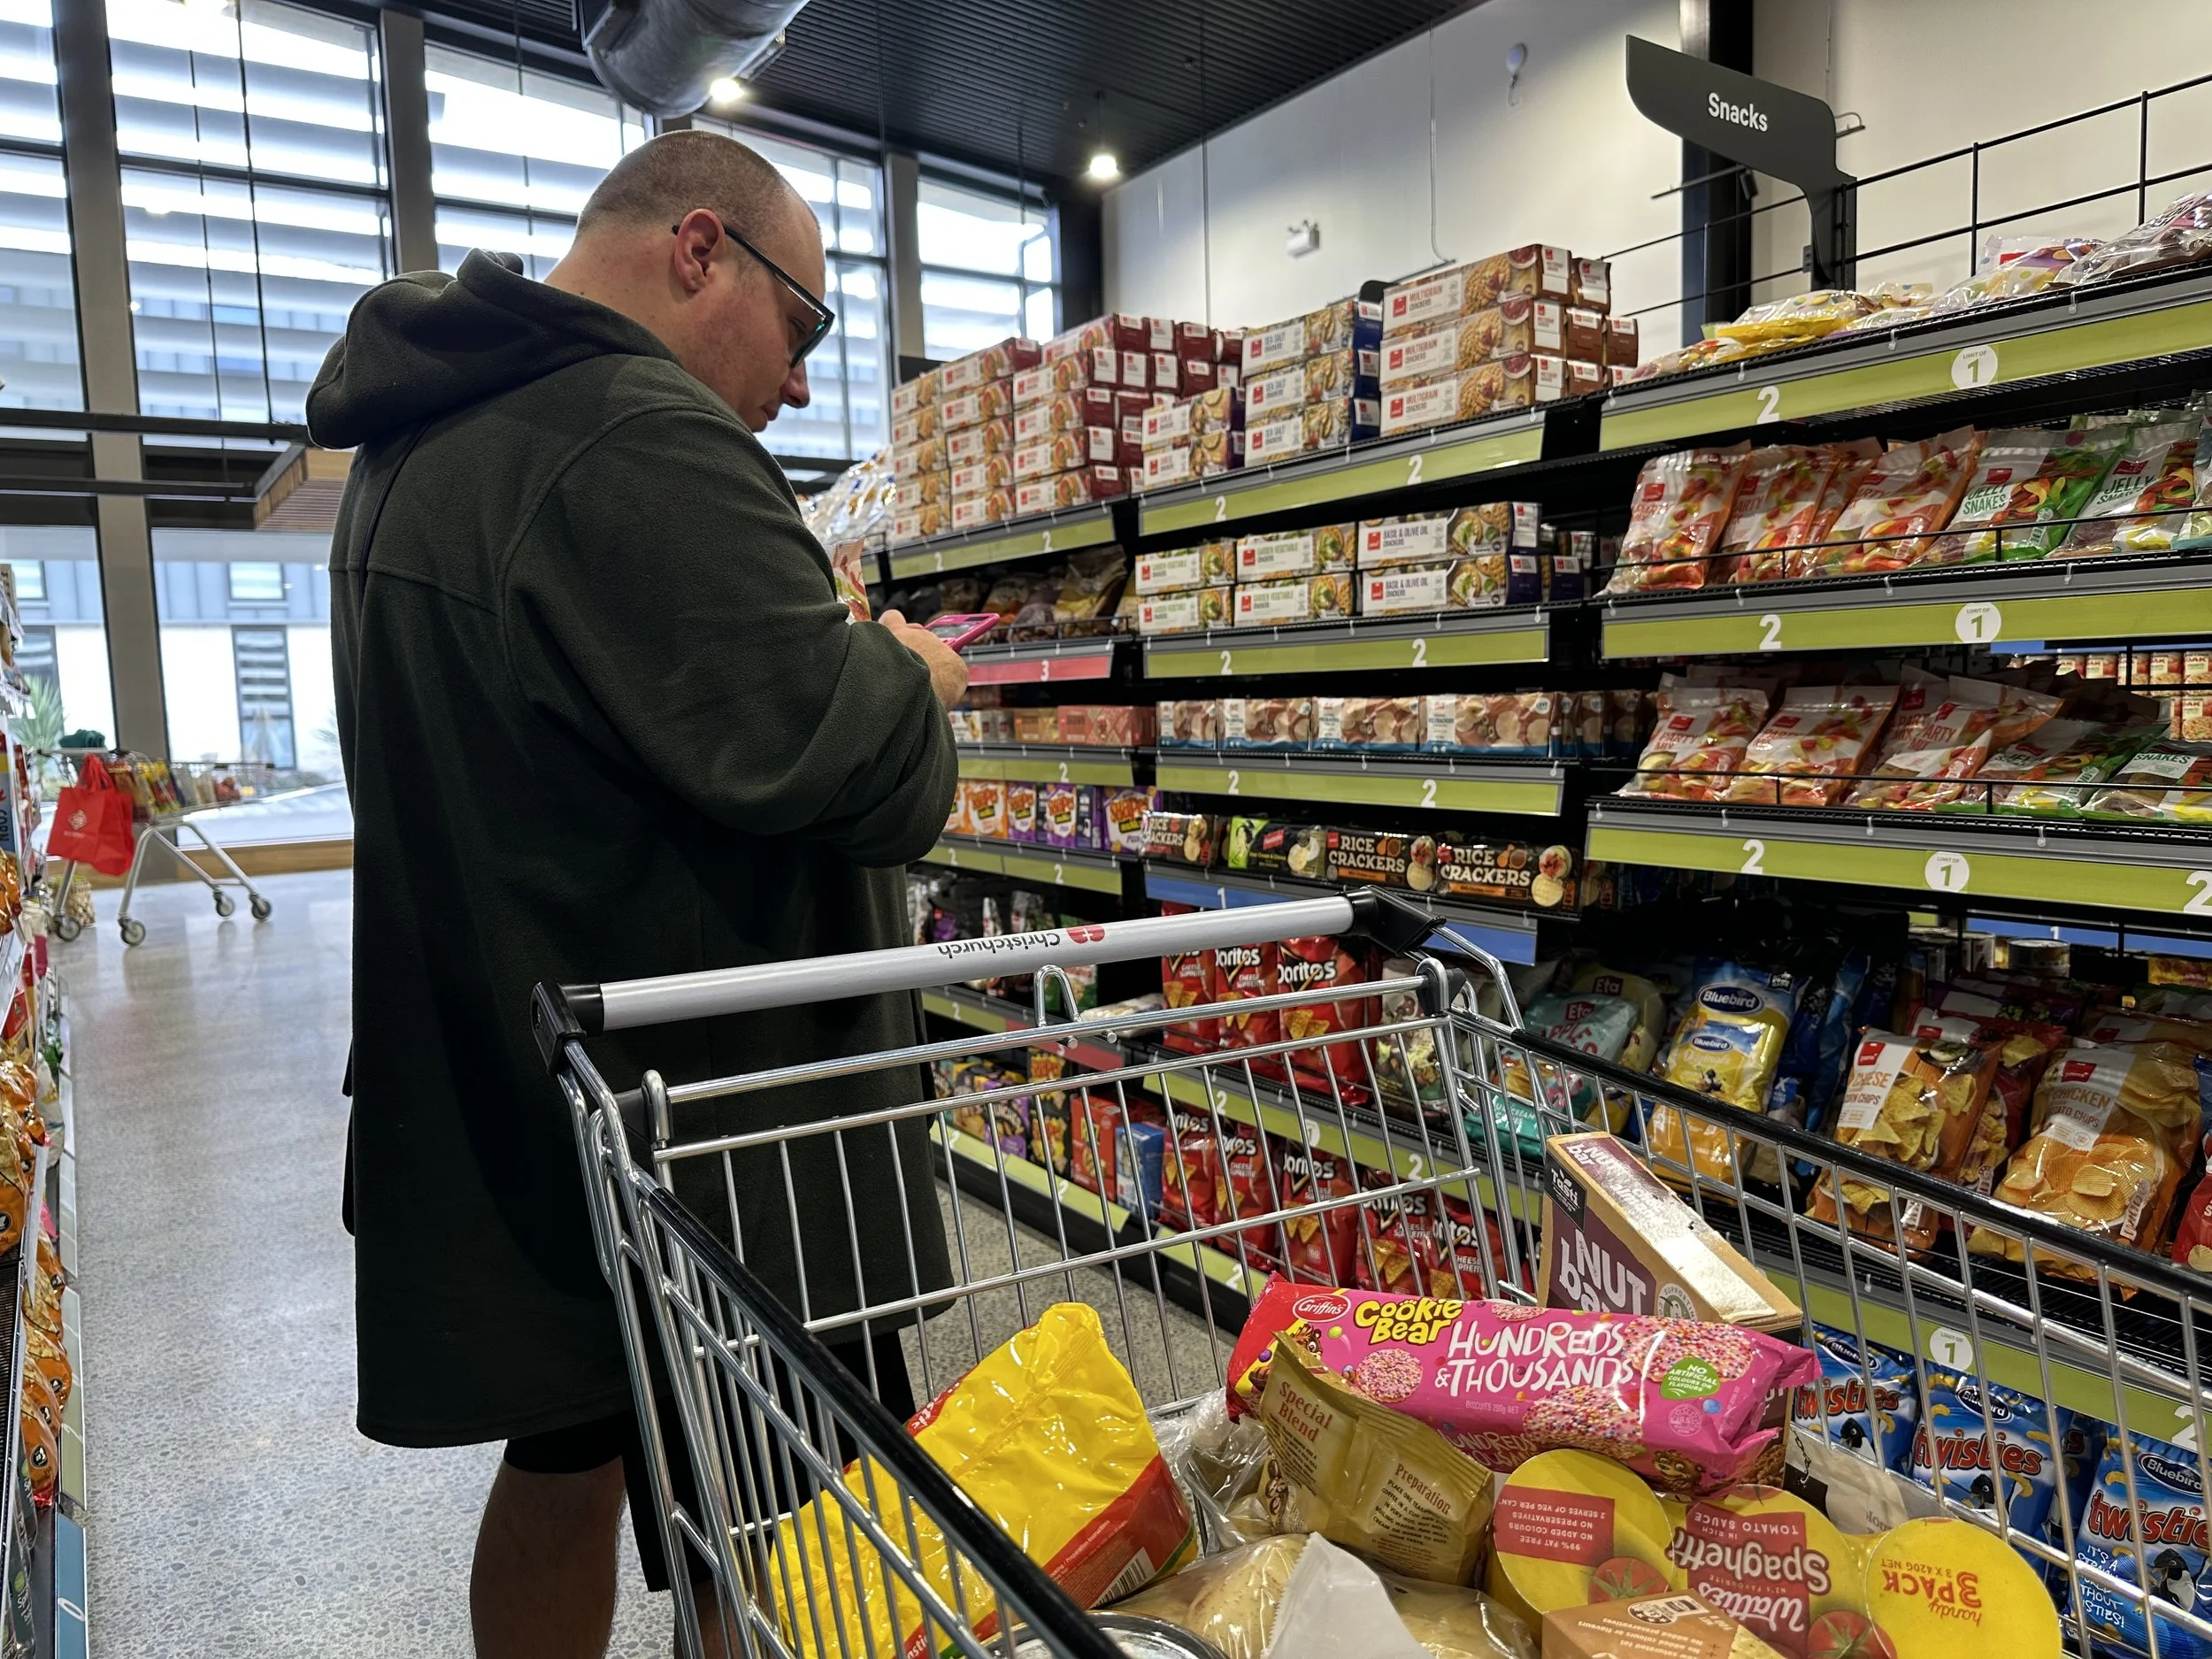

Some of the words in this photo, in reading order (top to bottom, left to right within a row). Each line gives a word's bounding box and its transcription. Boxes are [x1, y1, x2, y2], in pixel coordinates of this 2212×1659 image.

[1708, 92, 1768, 133] Snacks
[1409, 284, 1443, 302] MULTIGRAIN
[1404, 339, 1438, 355] MULTIGRAIN
[1967, 358, 1979, 383] 1
[1405, 388, 1440, 404] MULTIGRAIN
[1757, 386, 1781, 426] 2
[1407, 456, 1424, 486] 2
[1216, 495, 1227, 521] 2
[1963, 494, 2007, 516] SNAKES
[1042, 530, 1053, 550] 2
[1759, 614, 1782, 650] 2
[1970, 615, 1983, 638] 1
[1412, 638, 1427, 668] 2
[1041, 659, 1050, 681] 3
[1221, 650, 1233, 676] 2
[2134, 751, 2192, 764] SNAKES
[1059, 762, 1070, 783] 2
[1228, 770, 1240, 795] 2
[1420, 779, 1438, 808] 2
[1340, 835, 1375, 854] RICE
[949, 847, 959, 866] 2
[1329, 851, 1406, 874] CRACKERS
[1455, 848, 1494, 866] RICE
[1740, 839, 1765, 876] 2
[1054, 864, 1064, 885] 2
[1440, 865, 1531, 887] CRACKERS
[1939, 864, 1952, 887] 1
[1217, 886, 1227, 909] 1
[2183, 871, 2212, 918] 2
[2050, 926, 2060, 941] 1
[938, 932, 1061, 958] Christchurch
[1594, 979, 1621, 994] Eta
[1702, 989, 1757, 1010] Bluebird
[952, 1002, 962, 1020] 2
[1693, 1034, 1730, 1050] Bluebird
[1216, 1090, 1227, 1116] 2
[1858, 1094, 1881, 1105] CHIPS
[2051, 1086, 2111, 1112] CHICKEN
[2073, 1110, 2101, 1129] CHIPS
[1566, 1144, 1594, 1165] bar
[1408, 1152, 1424, 1181] 2
[1551, 1168, 1578, 1206] Tasti
[1226, 1263, 1243, 1289] 2
[1576, 1229, 1647, 1316] NUT
[1295, 1296, 1348, 1317] Griffin's
[1370, 1317, 1451, 1346] Bear
[1448, 1320, 1625, 1359] HUNDREDS
[1940, 1331, 1955, 1341] LIMIT
[1944, 1342, 1955, 1364] 1
[1434, 1367, 1452, 1388] &
[1448, 1356, 1635, 1397] THOUSANDS
[1669, 1369, 1717, 1386] ARTIFICIAL
[1688, 1363, 1708, 1374] NO
[1668, 1375, 1702, 1386] COLOURS
[1702, 1381, 1713, 1390] OR
[1669, 1381, 1704, 1393] FLAVOURS
[1279, 1380, 1333, 1430] Special
[1465, 1400, 1492, 1413] BISCUITS
[1507, 1405, 1519, 1415] NET
[1279, 1401, 1320, 1443] Blend
[2171, 1405, 2206, 1448] 2
[1914, 1423, 2042, 1477] twisties
[1381, 1487, 1398, 1503] COFFEE
[1387, 1479, 1404, 1494] PLACE
[1402, 1492, 1413, 1503] ONE
[1394, 1462, 1451, 1516] Preparation
[1375, 1505, 1394, 1524] BOILING
[1390, 1506, 1402, 1518] VERY
[1518, 1501, 1535, 1511] PER
[1536, 1502, 1553, 1513] VEG
[1554, 1505, 1567, 1515] OF
[1569, 1507, 1598, 1519] SERVES
[1599, 1510, 1606, 1520] 2
[1373, 1516, 1390, 1531] CREAM
[1402, 1530, 1422, 1539] SUGAR
[1512, 1510, 1578, 1528] PRESERVATIVES
[1580, 1521, 1593, 1530] NO
[1694, 1512, 1736, 1530] SAUCE
[1509, 1522, 1548, 1536] COLOURS
[1550, 1527, 1578, 1540] ADDED
[1580, 1532, 1593, 1541] NO
[1701, 1526, 1724, 1539] RICH
[1728, 1532, 1738, 1540] IN
[1741, 1522, 1799, 1536] TOMATO
[1519, 1535, 1542, 1546] FREE
[1544, 1539, 1560, 1549] FAT
[1562, 1541, 1580, 1552] 99%
[1667, 1528, 1829, 1595] Spaghetti
[1880, 1558, 1902, 1570] NET
[2087, 1545, 2109, 1564] IT'S
[2109, 1559, 2118, 1571] A
[1905, 1562, 1932, 1575] 420G
[1934, 1566, 1942, 1576] X
[1946, 1569, 1952, 1578] 3
[1708, 1573, 1762, 1594] FAVOURITE
[1881, 1570, 1955, 1602] PACK
[1956, 1571, 1983, 1609] 3
[1928, 1598, 1983, 1627] handy
[1578, 1620, 1612, 1635] flavours
[1601, 1617, 1661, 1637] preservatives
[1661, 1630, 1690, 1642] added
[1619, 1639, 1635, 1648] fat
[1625, 1632, 1657, 1644] colours
[1658, 1640, 1687, 1651] added
[1692, 1637, 1704, 1647] No
[1636, 1640, 1678, 1657] saturated
[1689, 1646, 1701, 1655] No
